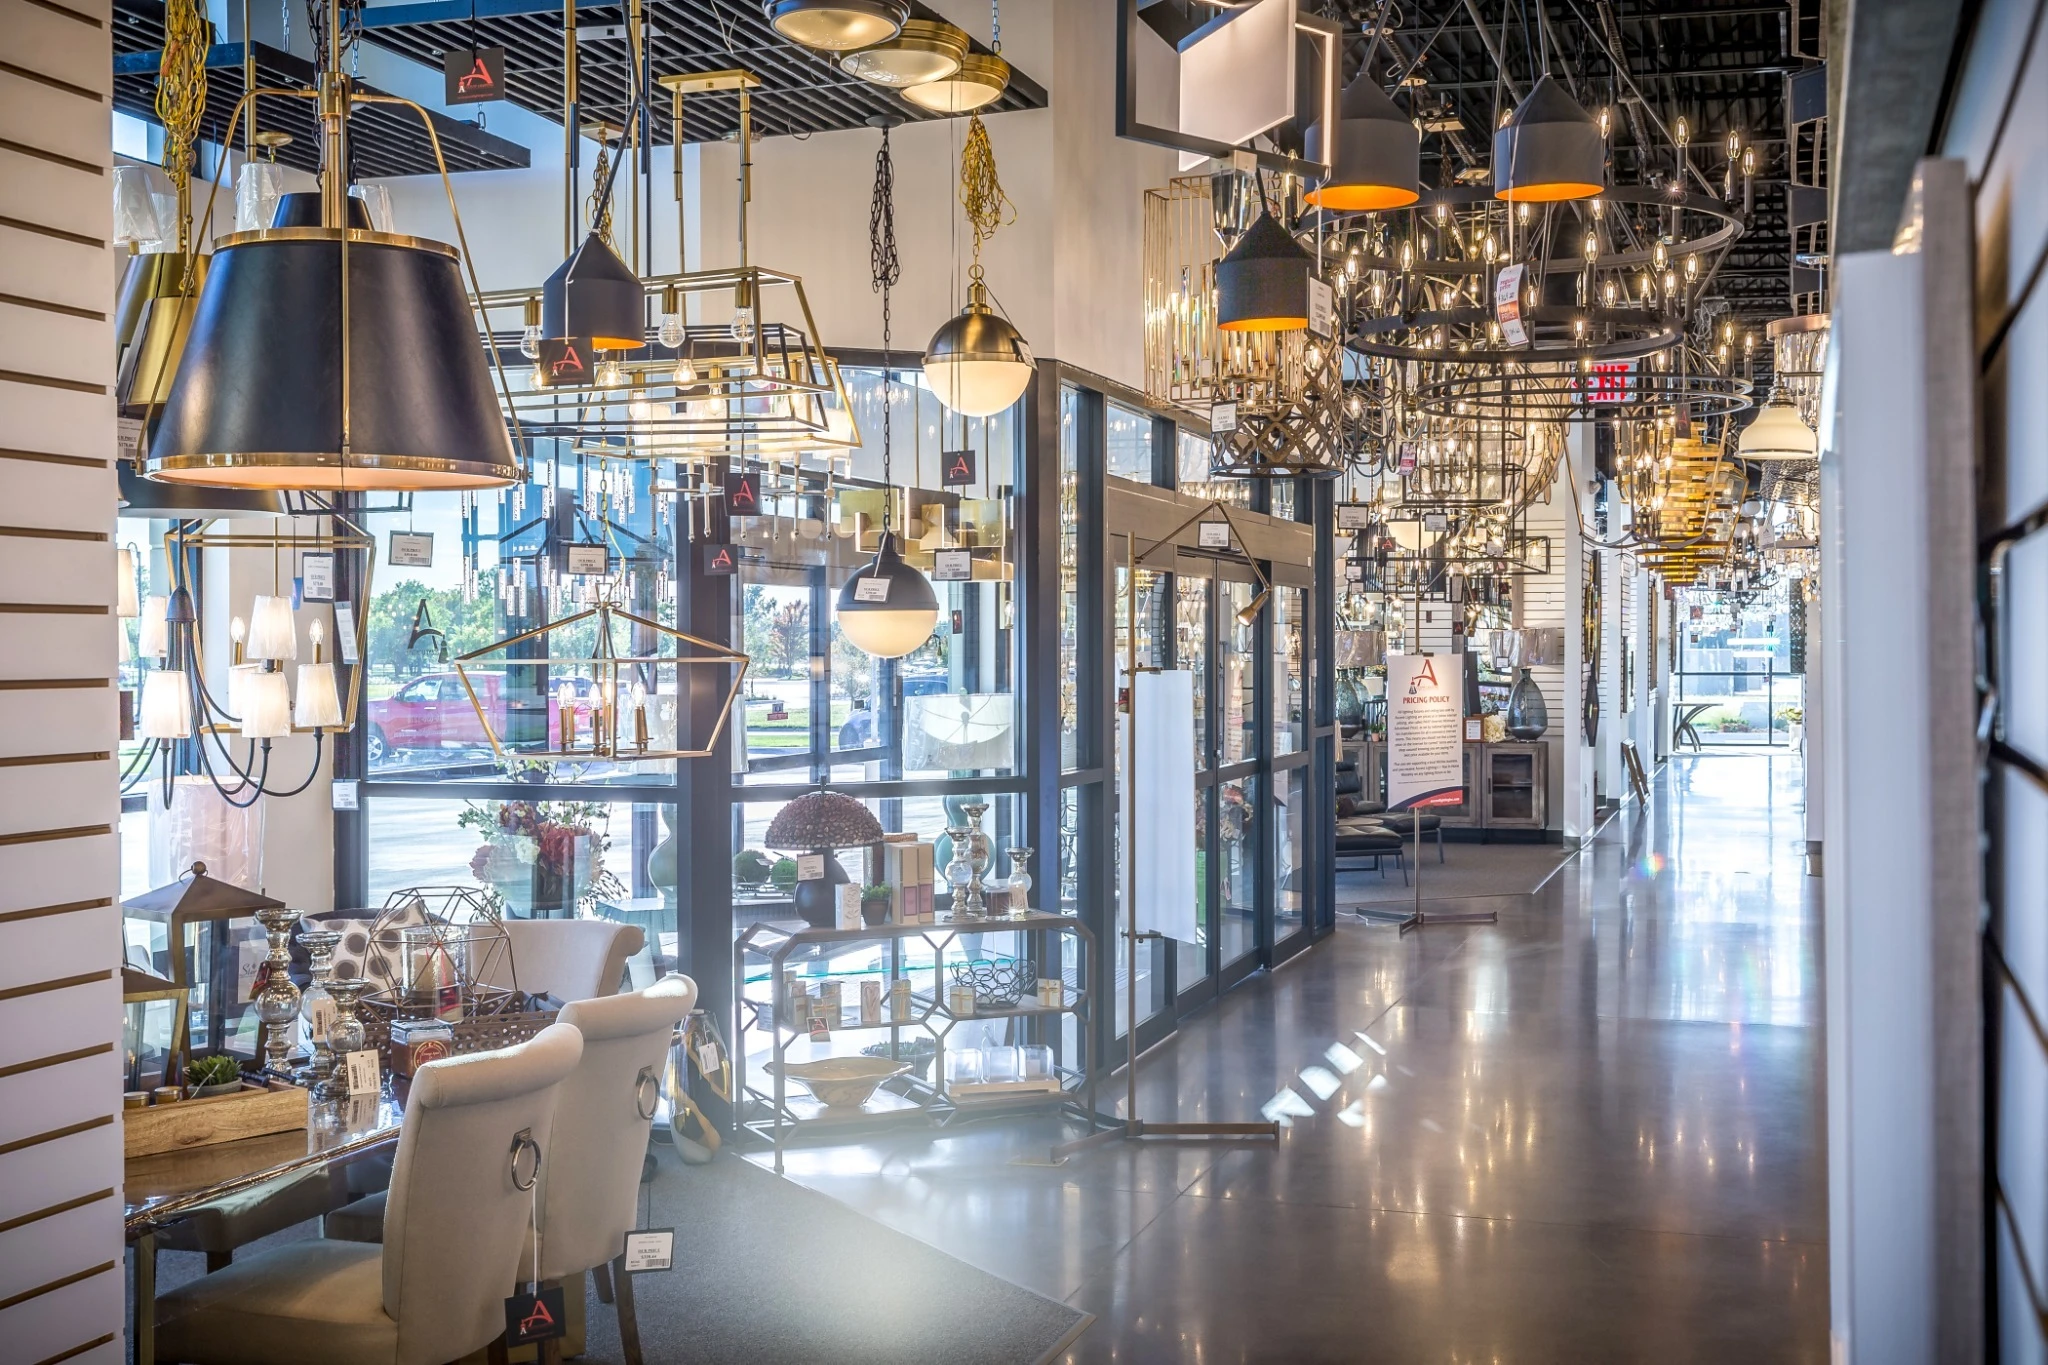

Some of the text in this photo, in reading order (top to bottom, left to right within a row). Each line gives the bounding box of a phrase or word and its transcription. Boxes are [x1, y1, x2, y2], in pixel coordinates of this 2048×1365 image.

[554, 346, 584, 370] A
[952, 456, 969, 475] A
[734, 480, 754, 502] A
[713, 549, 732, 566] A
[522, 1300, 555, 1328] A
